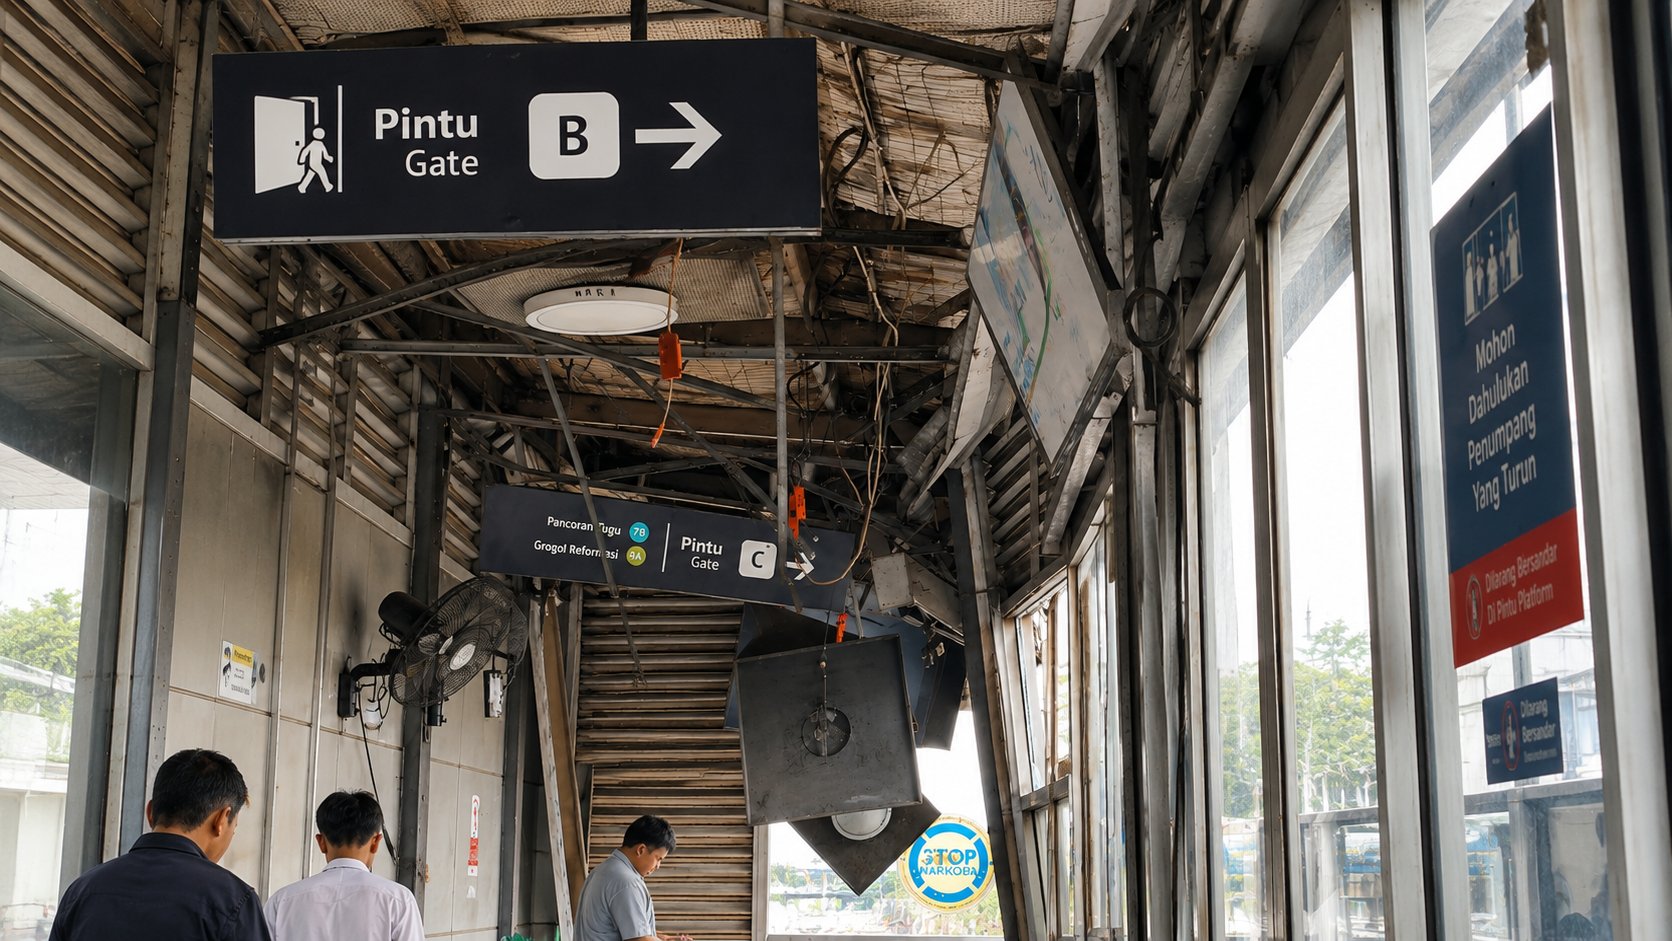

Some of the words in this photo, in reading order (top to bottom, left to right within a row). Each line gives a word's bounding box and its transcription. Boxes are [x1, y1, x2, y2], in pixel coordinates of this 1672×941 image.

[375, 107, 478, 140] Pintu
[559, 115, 589, 156] B
[405, 149, 479, 177] Gate
[1475, 323, 1515, 374] Mohon
[1468, 360, 1529, 425] Dahulukan
[1467, 403, 1537, 471] Penumpang
[1472, 476, 1501, 513] Yang
[1501, 454, 1537, 496] Turun
[547, 516, 594, 532] Pancoran
[533, 540, 567, 554] Grogol
[681, 536, 723, 555] Pintu
[751, 551, 765, 568] C
[691, 556, 720, 571] Gate
[1485, 564, 1517, 594] Dilarang
[1516, 542, 1558, 579] Bersandar
[1487, 602, 1497, 625] Di
[1497, 597, 1517, 621] Pintu
[1518, 583, 1554, 613] Platform
[919, 866, 978, 877] NARKOBA
